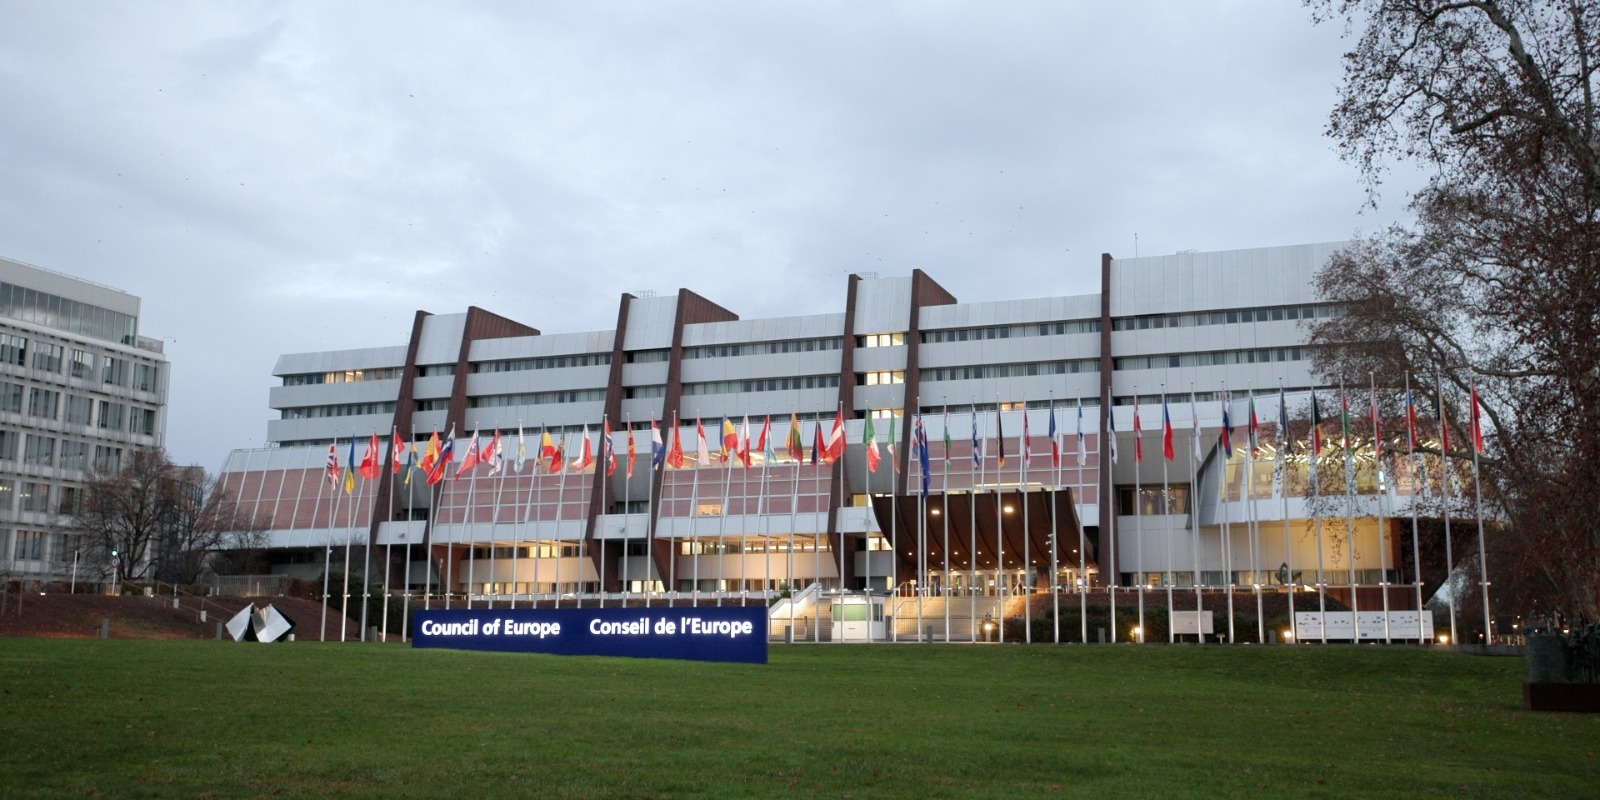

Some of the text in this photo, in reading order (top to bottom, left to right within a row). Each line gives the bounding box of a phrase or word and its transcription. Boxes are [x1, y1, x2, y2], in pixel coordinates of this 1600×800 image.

[421, 619, 561, 639] Council of Europe
[589, 617, 650, 635] Conseil
[654, 617, 677, 635] de
